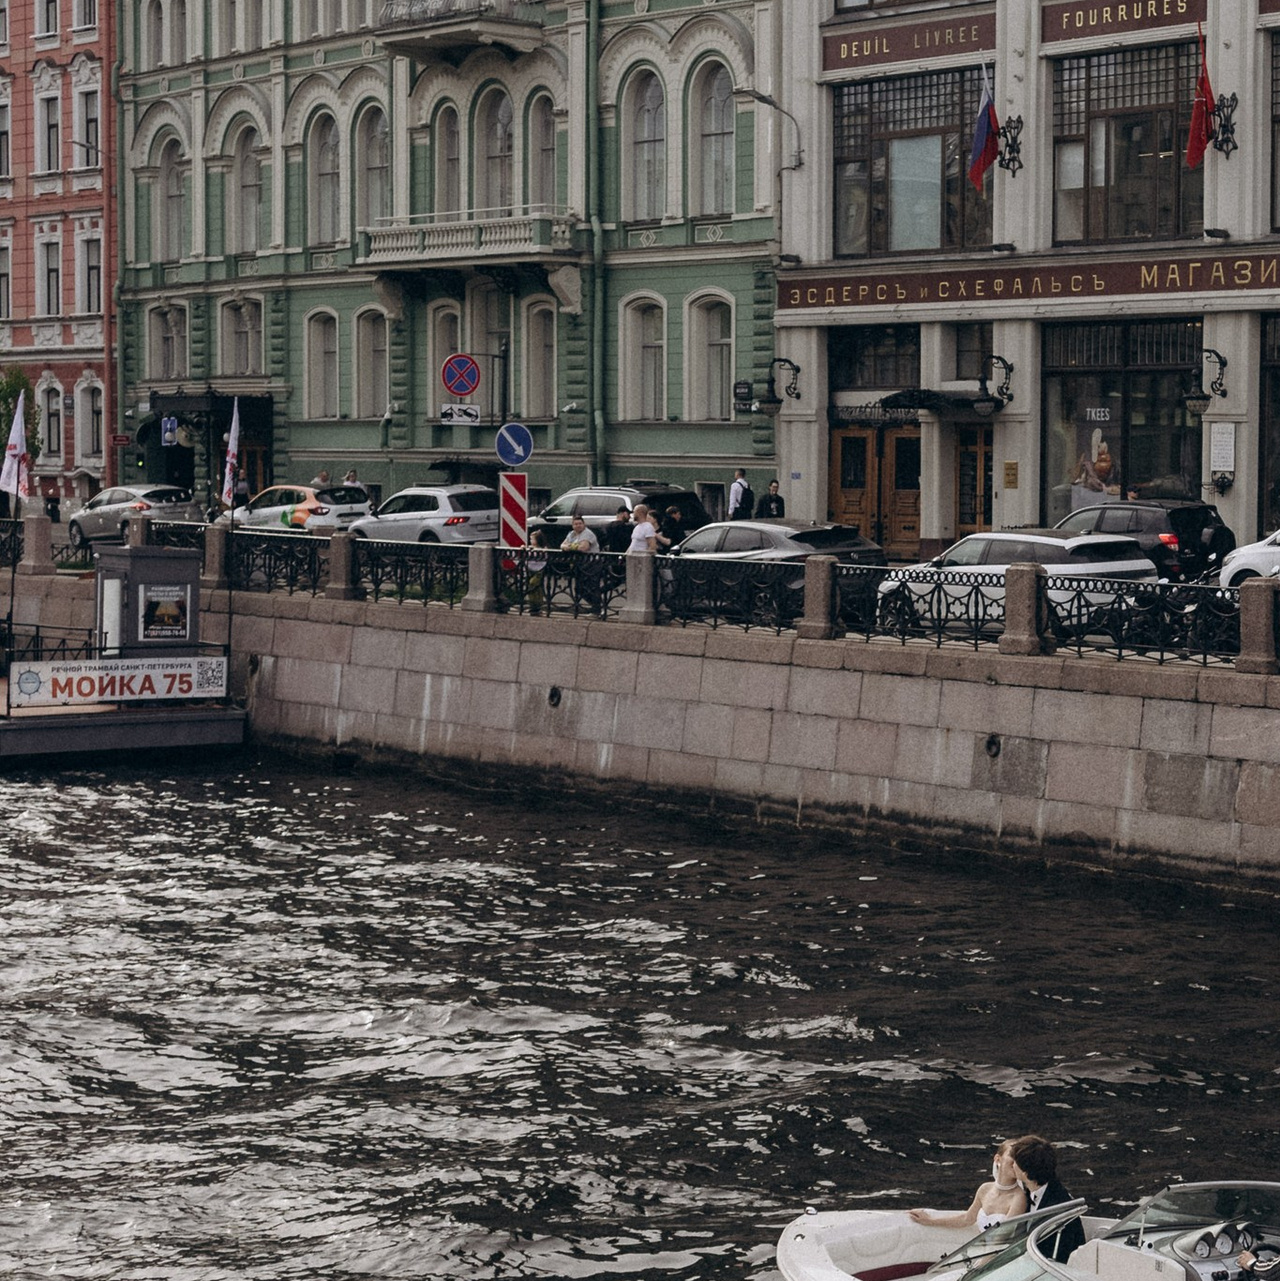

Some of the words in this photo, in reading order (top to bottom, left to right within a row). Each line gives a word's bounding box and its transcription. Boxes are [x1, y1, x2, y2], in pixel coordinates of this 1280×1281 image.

[790, 283, 907, 305] ЭСДЕРСЪ
[938, 274, 1106, 299] СХЕФАЛЬСЪ
[1086, 407, 1111, 422] TKEES
[83, 662, 120, 672] ТРАМВАЙ
[120, 662, 192, 671] САНКТ-ПЕТЕРБУРГА
[51, 672, 157, 699] МОЙКА
[162, 673, 193, 695] 75
